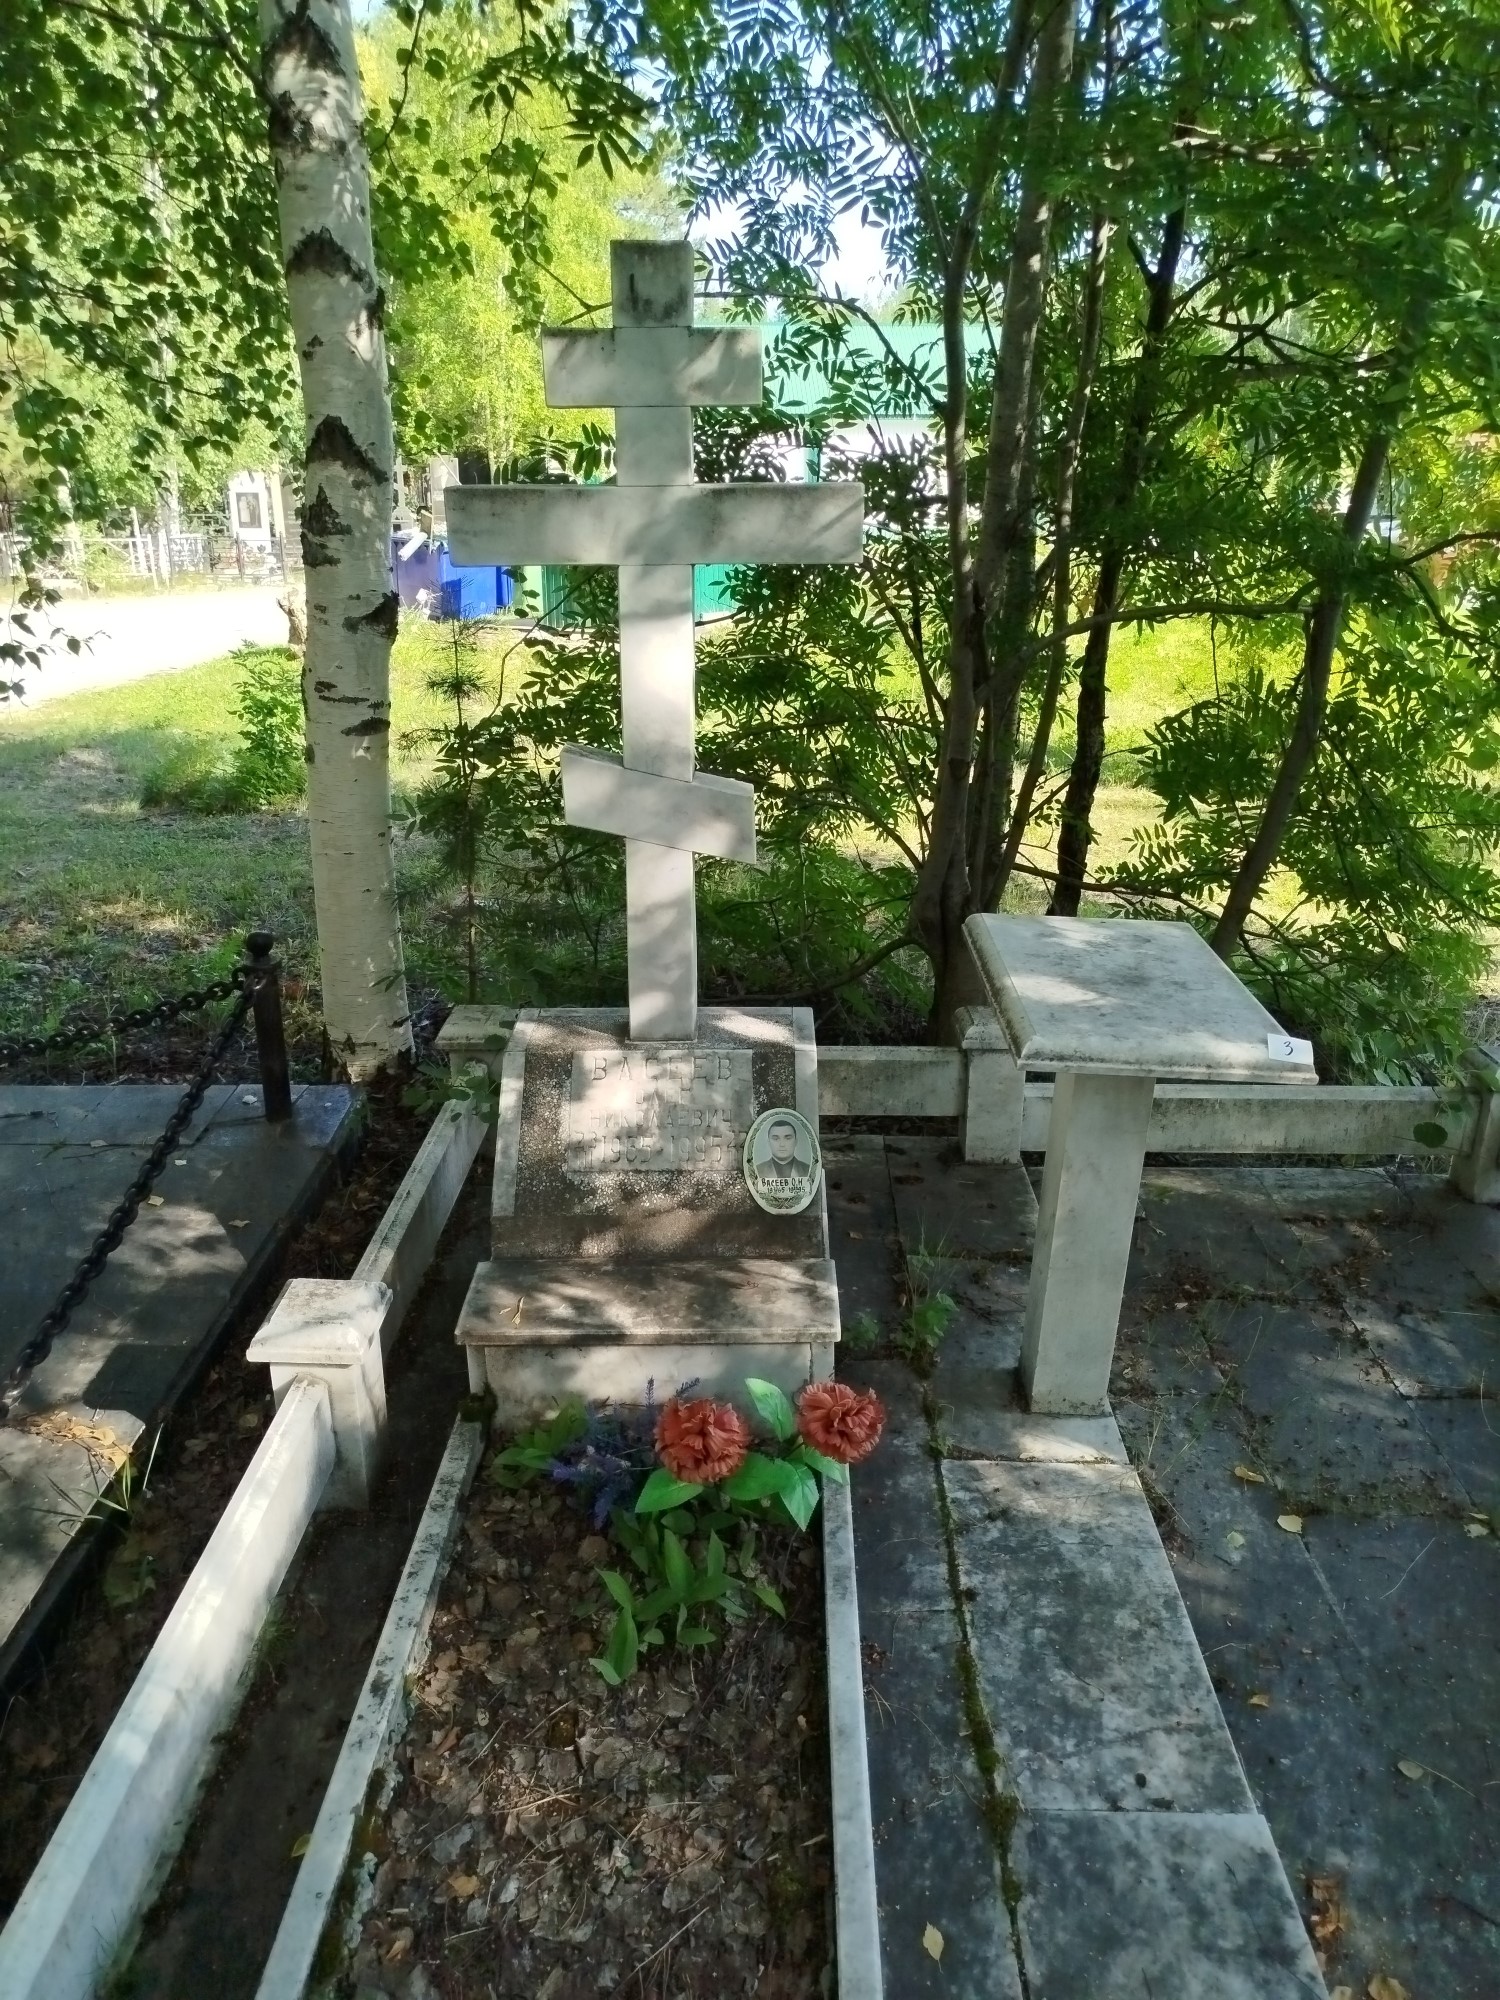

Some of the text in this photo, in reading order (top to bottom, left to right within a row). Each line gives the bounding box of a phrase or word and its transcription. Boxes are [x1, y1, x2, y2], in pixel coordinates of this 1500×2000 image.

[1283, 1040, 1294, 1056] 3
[591, 1056, 732, 1081] ВАСЕЕВ
[589, 1109, 732, 1128] НИКОЛАЕВИЧ
